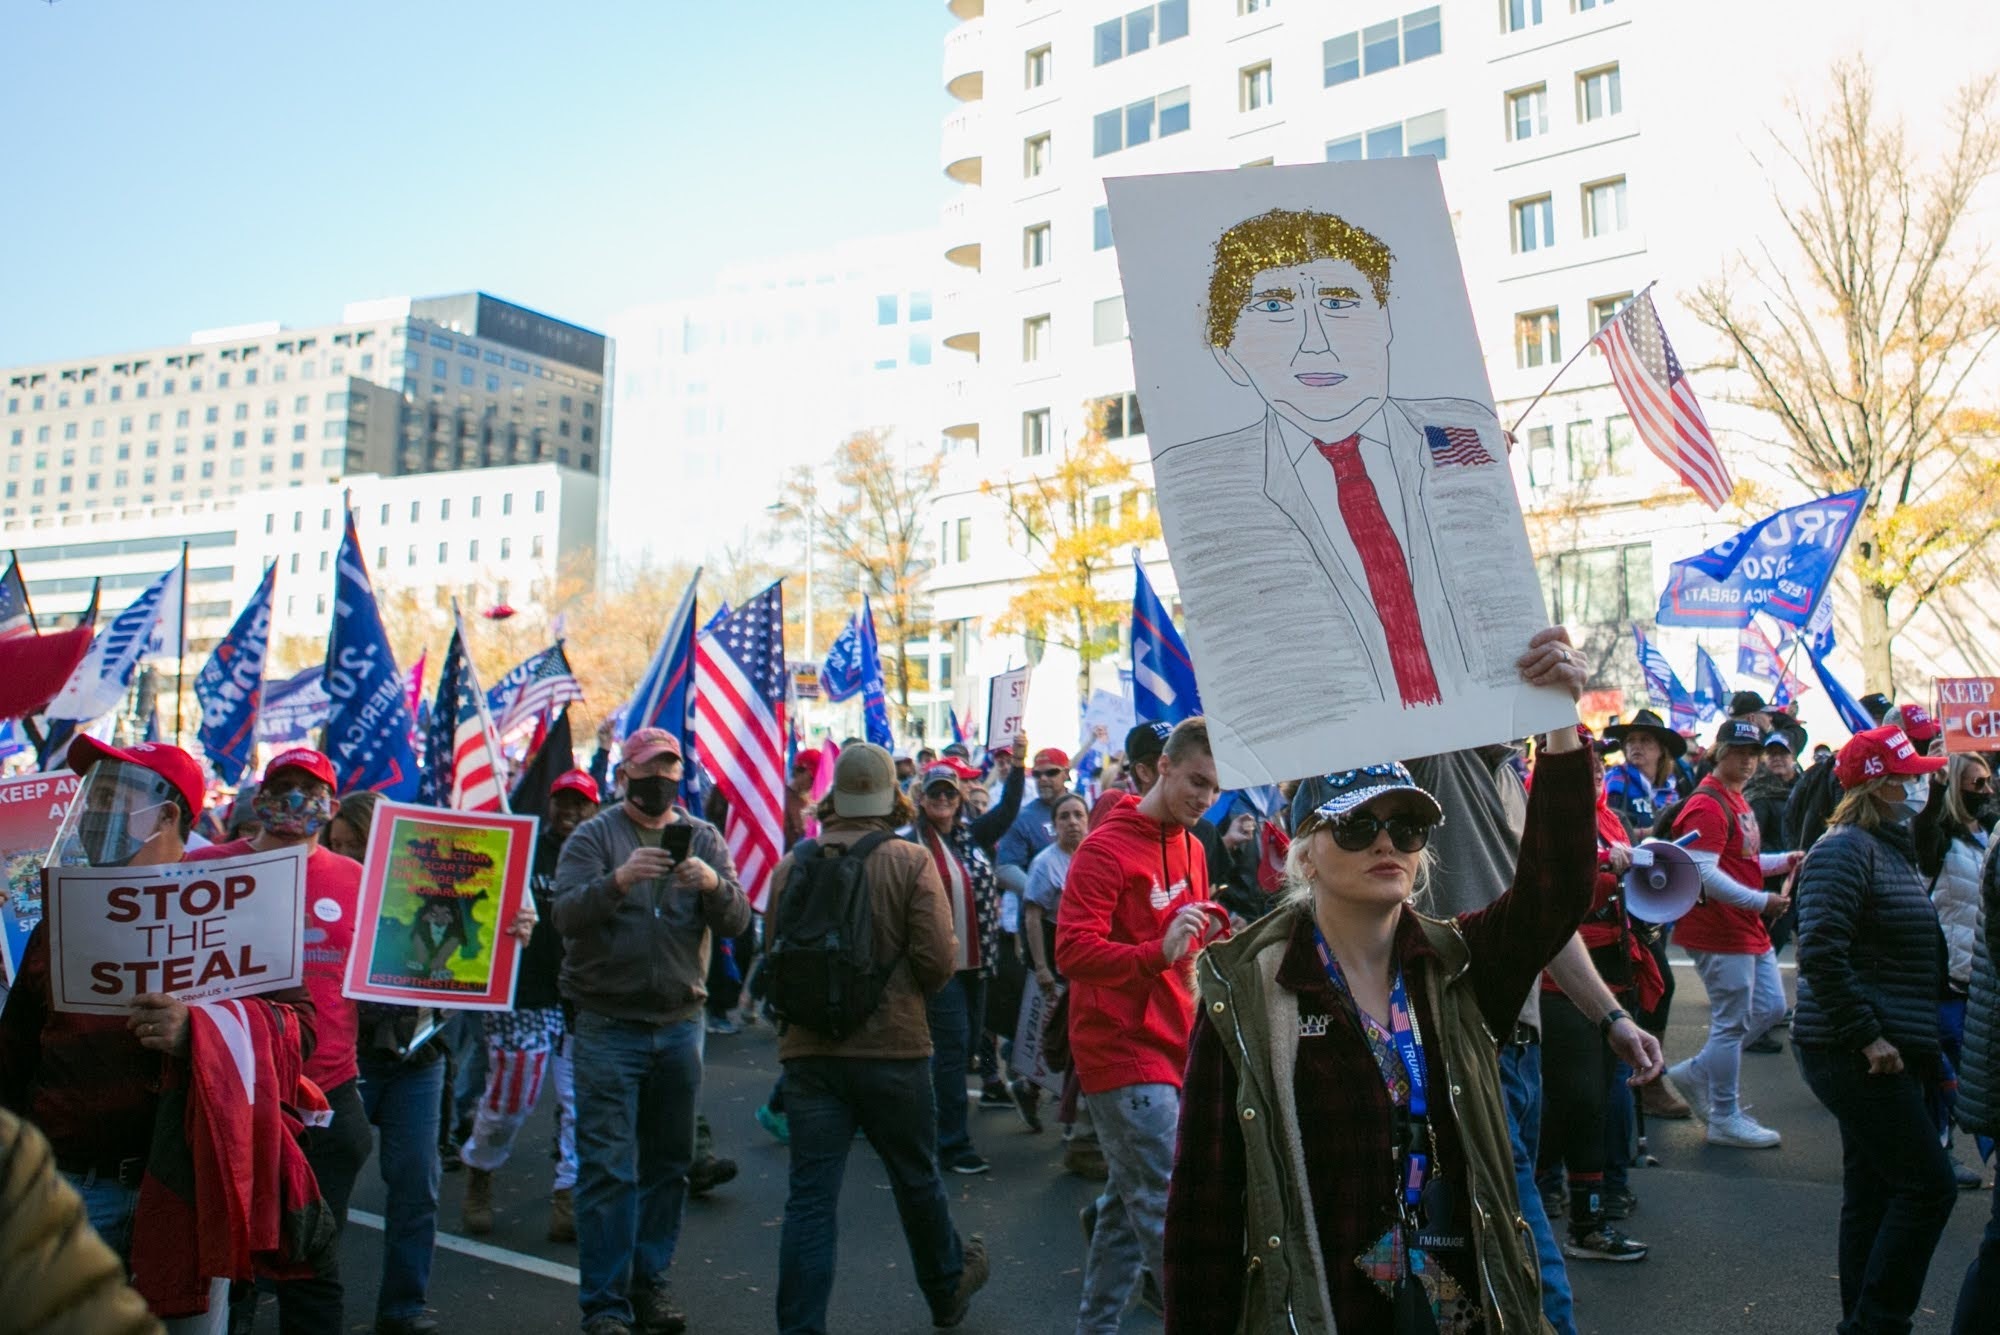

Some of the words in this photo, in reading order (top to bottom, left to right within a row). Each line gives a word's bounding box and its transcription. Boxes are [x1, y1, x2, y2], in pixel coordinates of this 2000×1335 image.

[1938, 682, 1995, 704] KEEP
[1864, 756, 1884, 775] 45
[424, 861, 456, 873] SCAR
[431, 849, 489, 863] ELECTION
[106, 875, 256, 922] STOP
[136, 916, 227, 957] THE
[90, 945, 267, 995] STEAL
[178, 987, 222, 1002] Steal.US
[1022, 996, 1042, 1060] GREAT!
[1403, 1042, 1422, 1087] TRUMP
[1419, 1236, 1432, 1246] I'M
